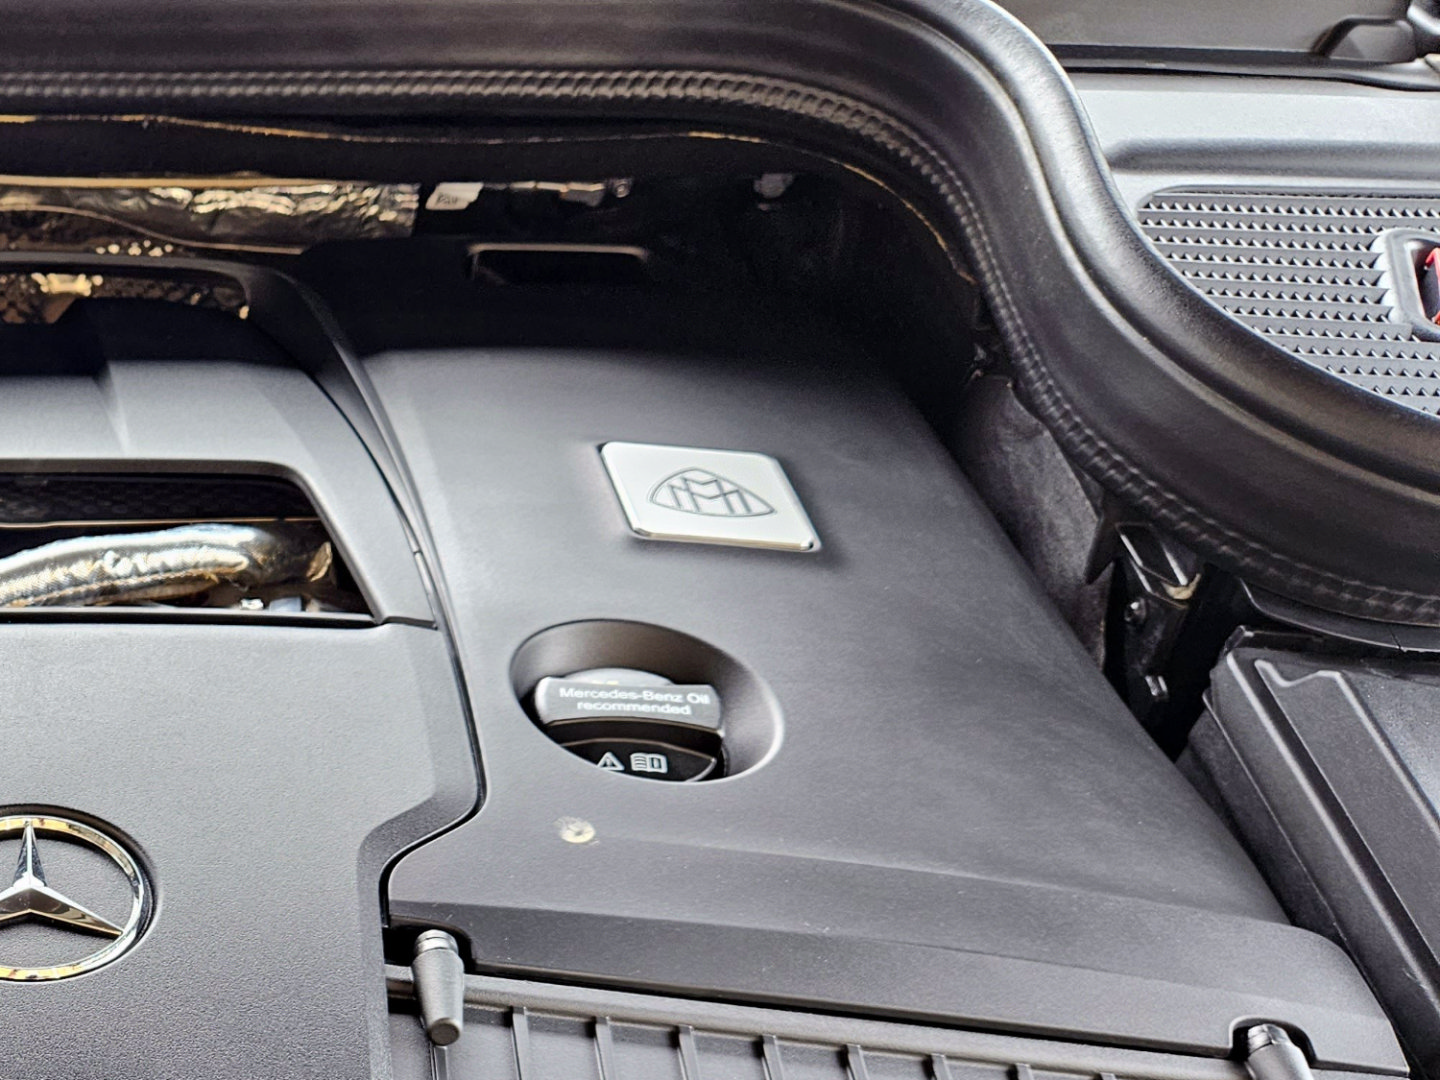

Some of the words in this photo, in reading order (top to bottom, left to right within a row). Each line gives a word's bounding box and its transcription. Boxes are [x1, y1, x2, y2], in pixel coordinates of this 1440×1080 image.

[559, 687, 683, 703] Mercedes-Benz
[686, 692, 711, 705] Oil
[577, 700, 692, 715] recommended
